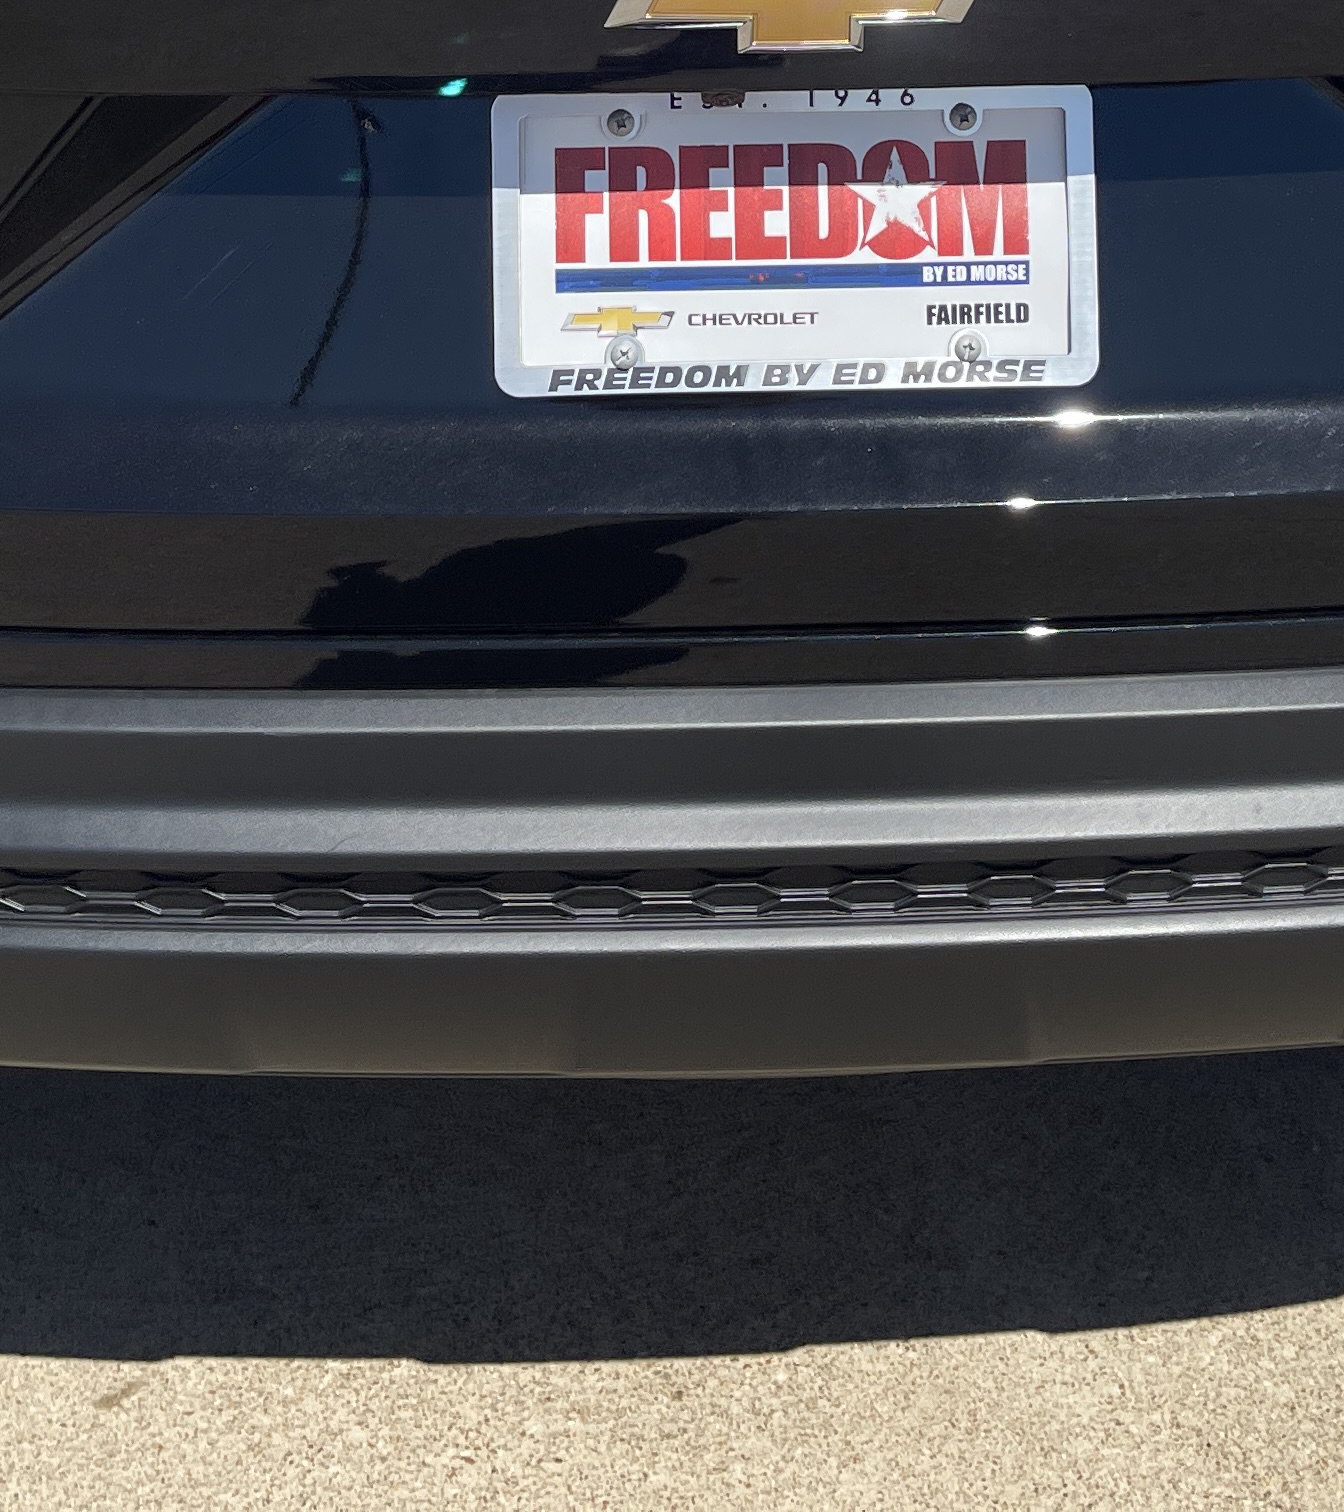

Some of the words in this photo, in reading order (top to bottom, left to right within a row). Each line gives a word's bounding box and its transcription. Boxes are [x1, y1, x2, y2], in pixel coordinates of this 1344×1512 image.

[809, 88, 914, 107] 1946
[555, 139, 1031, 263] FREEDOM
[922, 266, 946, 282] BY
[947, 265, 969, 281] ED
[970, 264, 1027, 280] MORSE
[687, 311, 819, 326] CHEVROLET
[926, 303, 1030, 326] FAIRFIELD
[548, 363, 750, 392] FREEDOM
[761, 363, 821, 387] BY
[831, 362, 890, 386] ED
[900, 358, 1047, 384] MORSE
